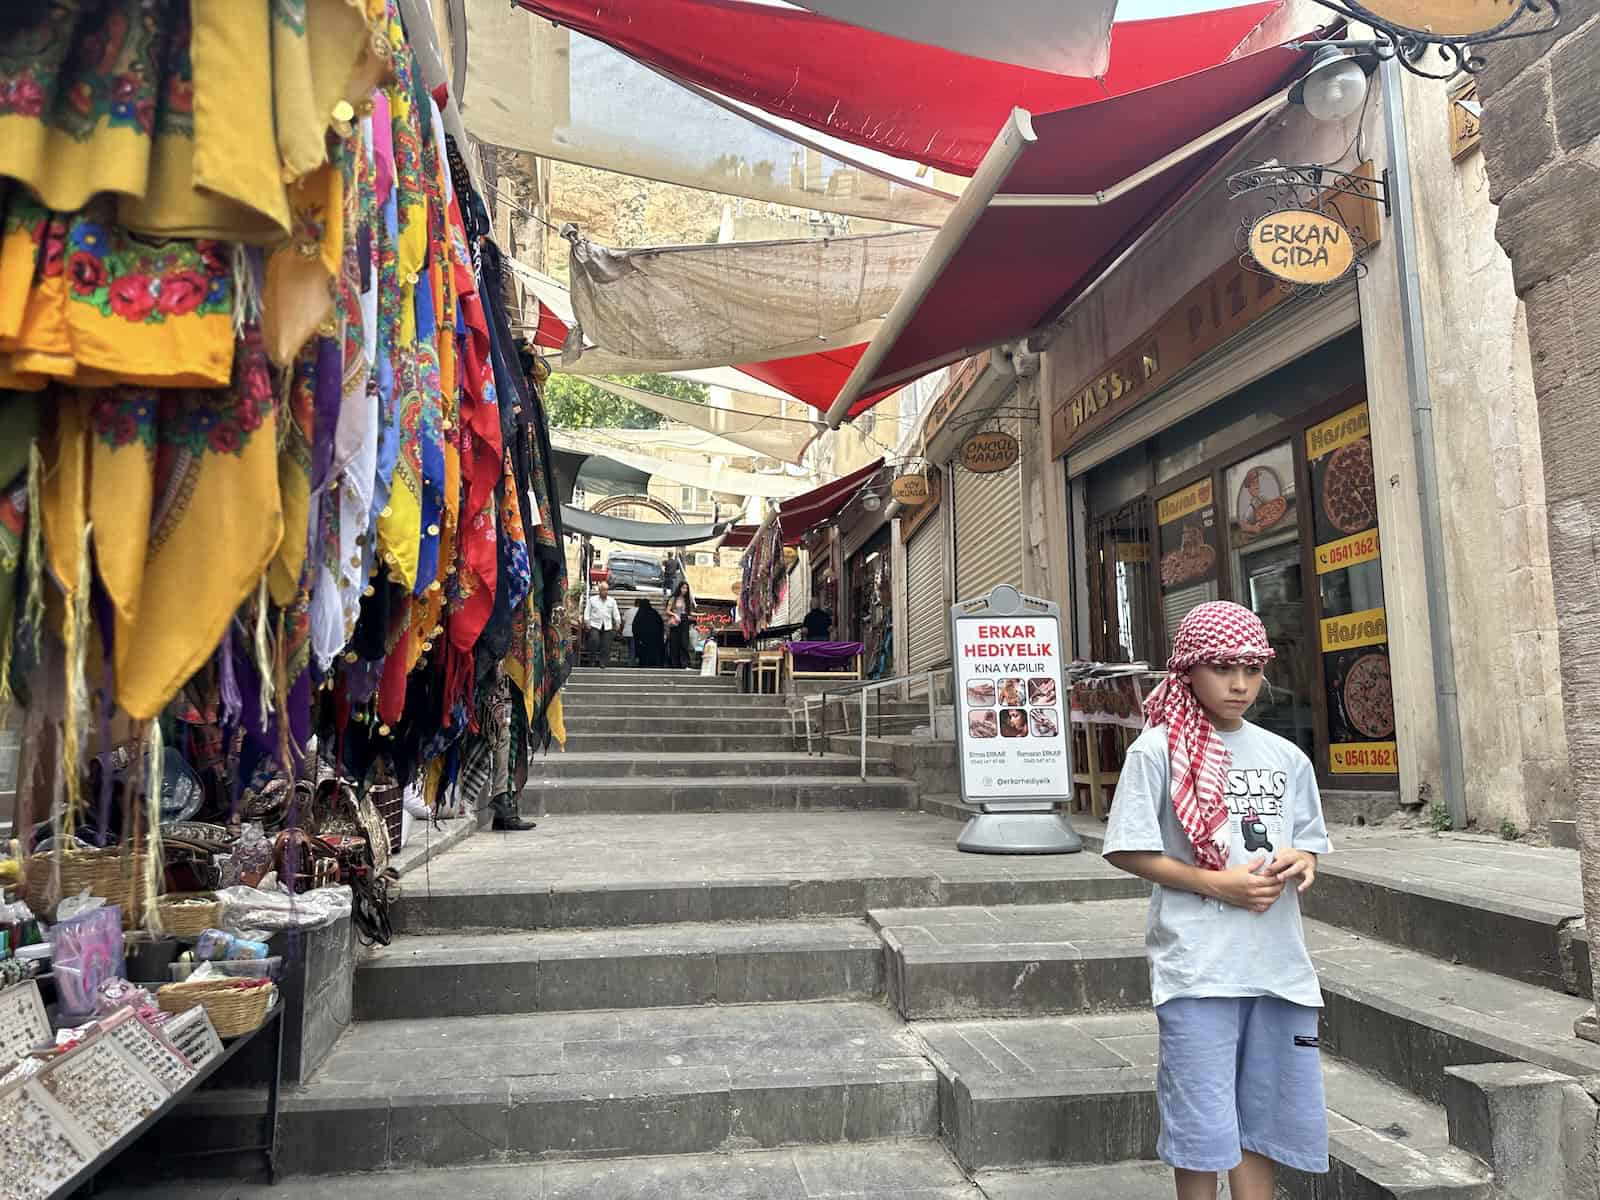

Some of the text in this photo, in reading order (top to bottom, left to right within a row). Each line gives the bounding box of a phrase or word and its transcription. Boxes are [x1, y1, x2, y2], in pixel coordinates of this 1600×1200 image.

[1260, 223, 1339, 245] ERKAN
[1271, 246, 1329, 268] GIDA
[1329, 541, 1353, 564] 0541
[1354, 537, 1373, 558] 362
[978, 625, 1036, 639] ERKAR
[975, 663, 1046, 673] KINA YAPILIR
[1345, 751, 1369, 766] 0541
[1370, 750, 1392, 766] 362
